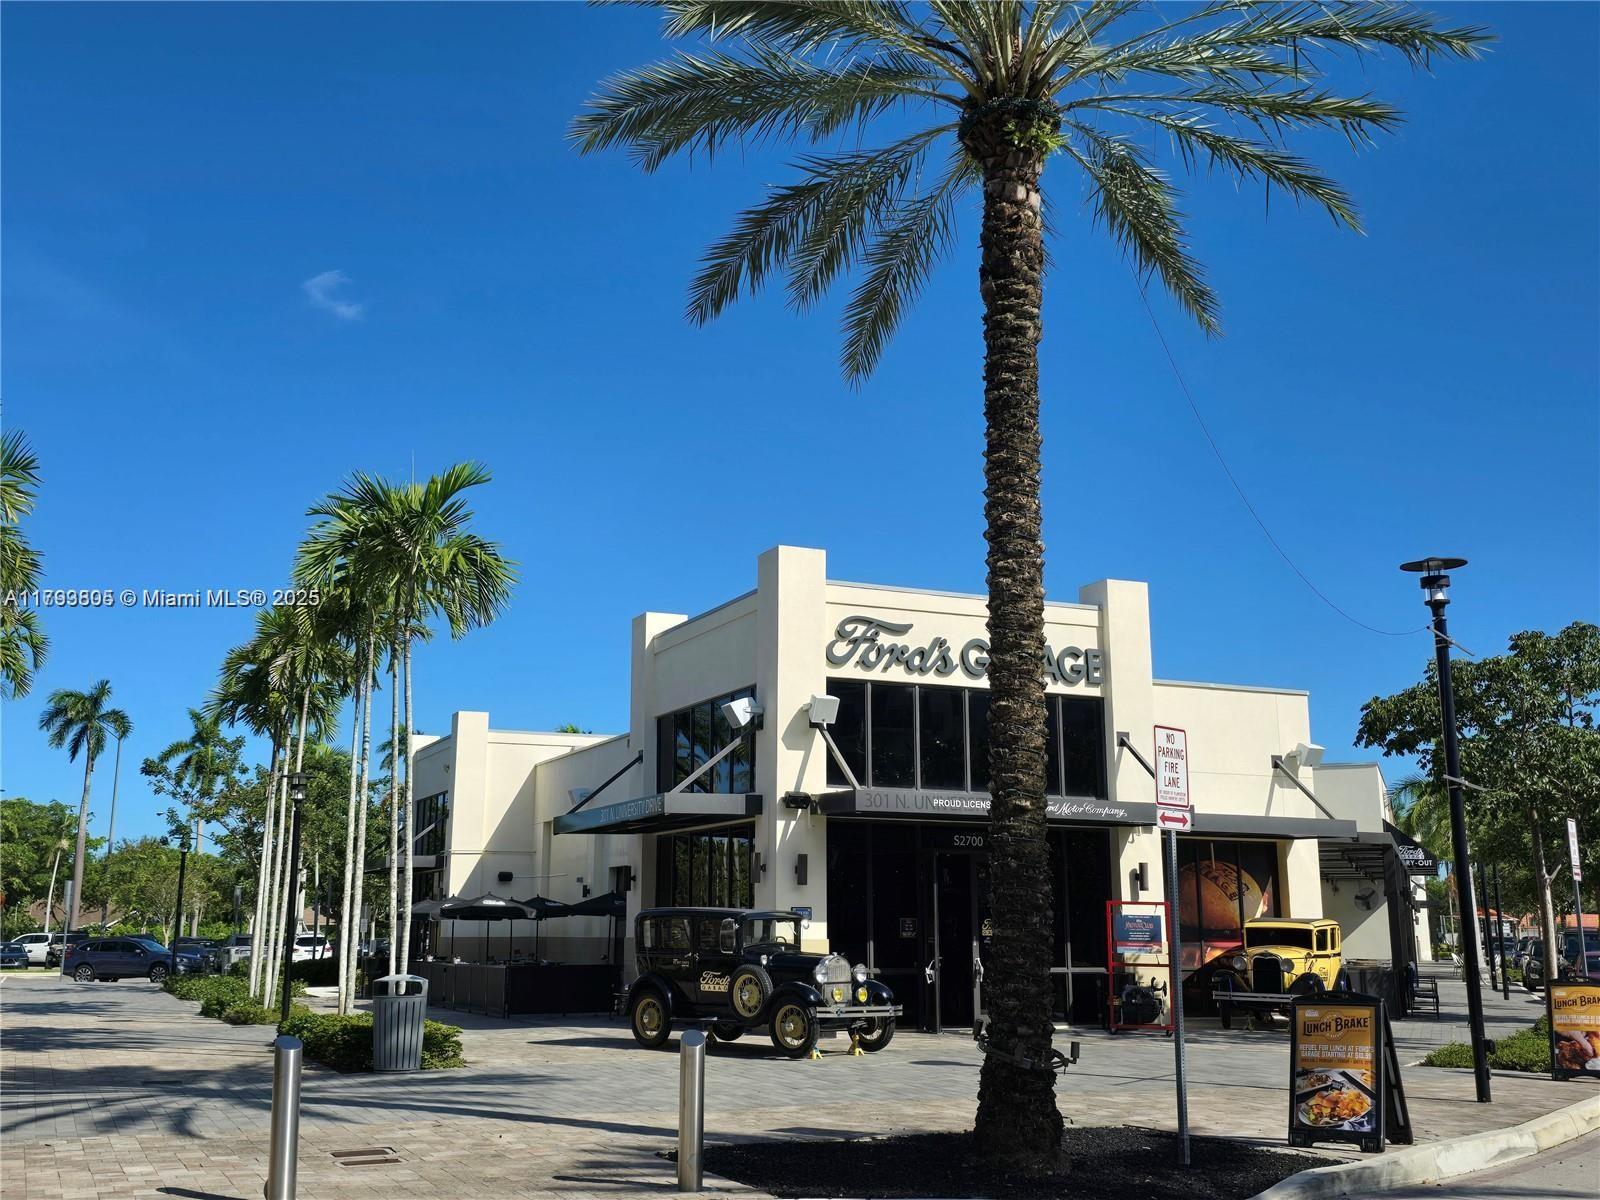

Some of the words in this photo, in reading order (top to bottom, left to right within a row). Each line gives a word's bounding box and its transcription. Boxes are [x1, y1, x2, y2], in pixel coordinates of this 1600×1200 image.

[826, 615, 960, 677] Ford's
[959, 637, 1105, 687] GAGE
[1165, 732, 1175, 745] NO
[1157, 745, 1185, 761] PARKING
[1164, 761, 1179, 774] FIRE
[1163, 776, 1181, 788] LANE
[865, 792, 889, 809] 301
[895, 793, 910, 809] N.
[933, 799, 961, 808] PROUD
[1053, 802, 1083, 816] Motor
[1082, 802, 1128, 818] Company
[953, 835, 984, 847] S2700
[1553, 998, 1578, 1010] LUNCH
[1303, 1020, 1332, 1037] LUNCH
[1334, 1016, 1369, 1033] BRAKE
